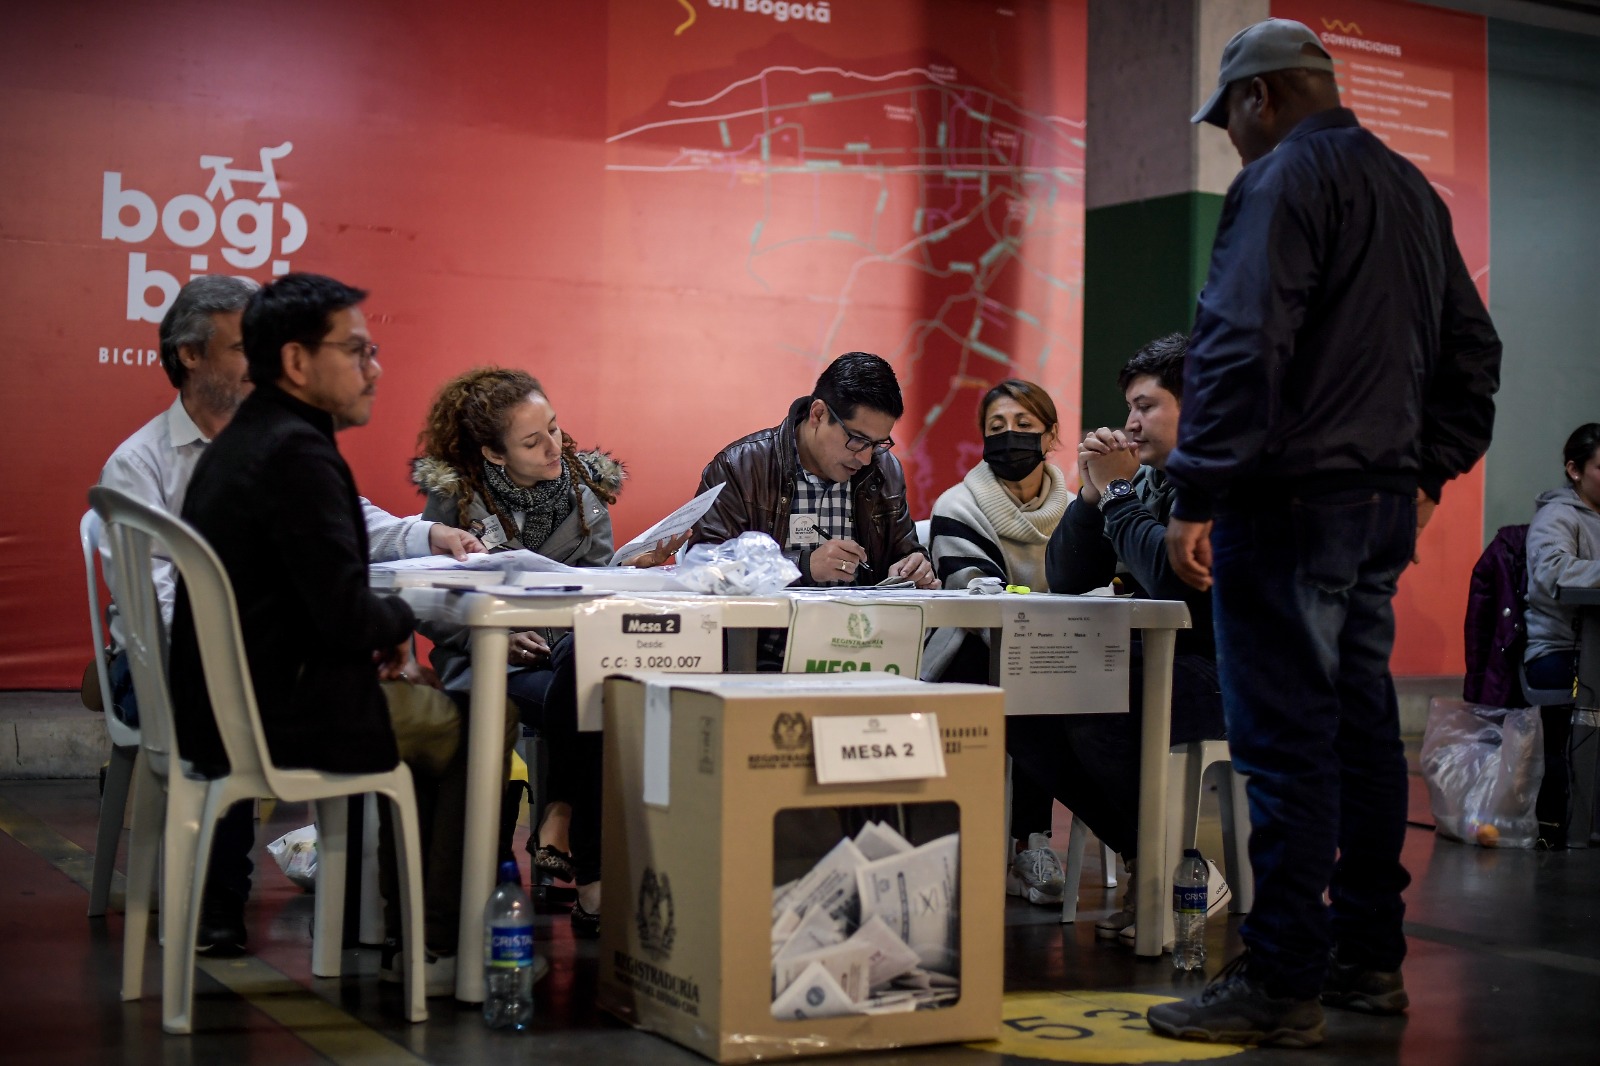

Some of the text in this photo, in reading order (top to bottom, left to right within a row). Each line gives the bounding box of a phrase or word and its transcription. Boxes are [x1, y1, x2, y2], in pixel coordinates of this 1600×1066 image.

[1321, 32, 1402, 57] CONVENCIONES
[99, 347, 163, 367] BICIP
[627, 619, 675, 632] Mesa 2
[634, 656, 702, 669] 3.020.007
[841, 742, 915, 760] MESA 2
[1184, 892, 1208, 901] CRIST
